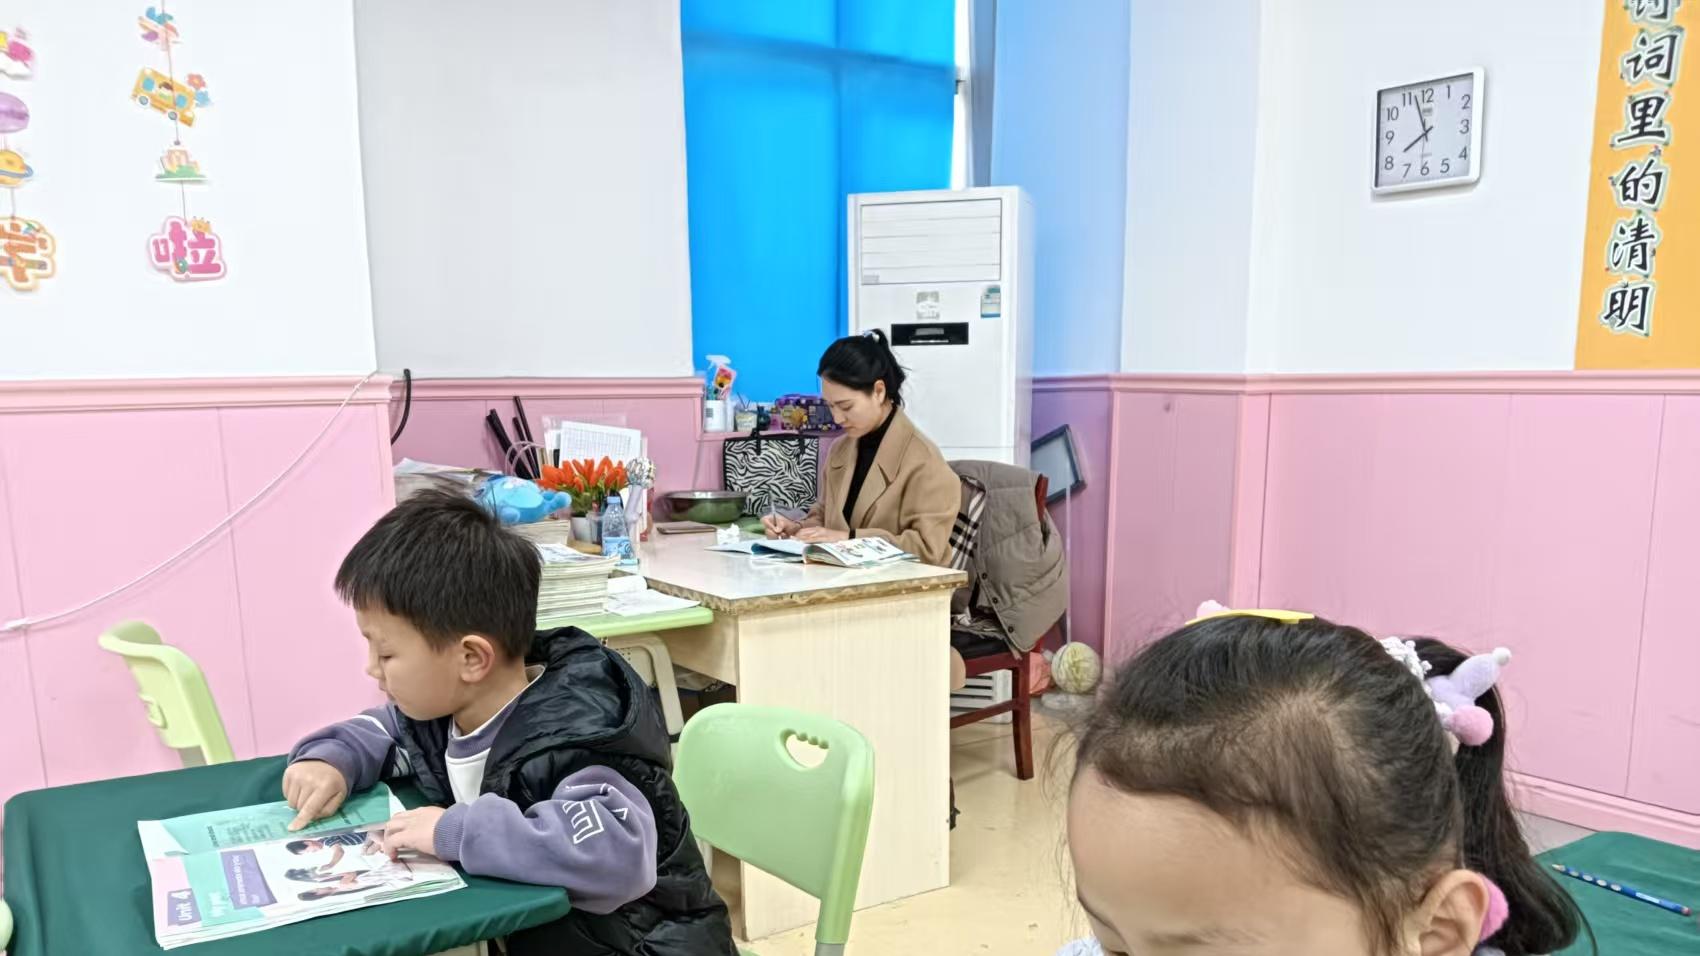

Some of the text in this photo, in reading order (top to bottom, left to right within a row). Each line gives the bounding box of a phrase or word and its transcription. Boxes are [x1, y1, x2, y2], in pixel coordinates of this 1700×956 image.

[1402, 92, 1412, 107] 11
[1421, 88, 1434, 104] 12
[1446, 85, 1451, 99] 1
[1461, 94, 1471, 109] 2
[1386, 106, 1399, 121] 10
[1459, 119, 1470, 134] 3
[1385, 130, 1395, 144] 9
[1458, 146, 1468, 160] 4
[1384, 155, 1394, 170] 8
[1420, 161, 1430, 176] 6
[1440, 158, 1450, 174] 5
[1402, 163, 1412, 178] 7
[151, 220, 222, 275] 啦
[170, 890, 193, 921] Unit 4
